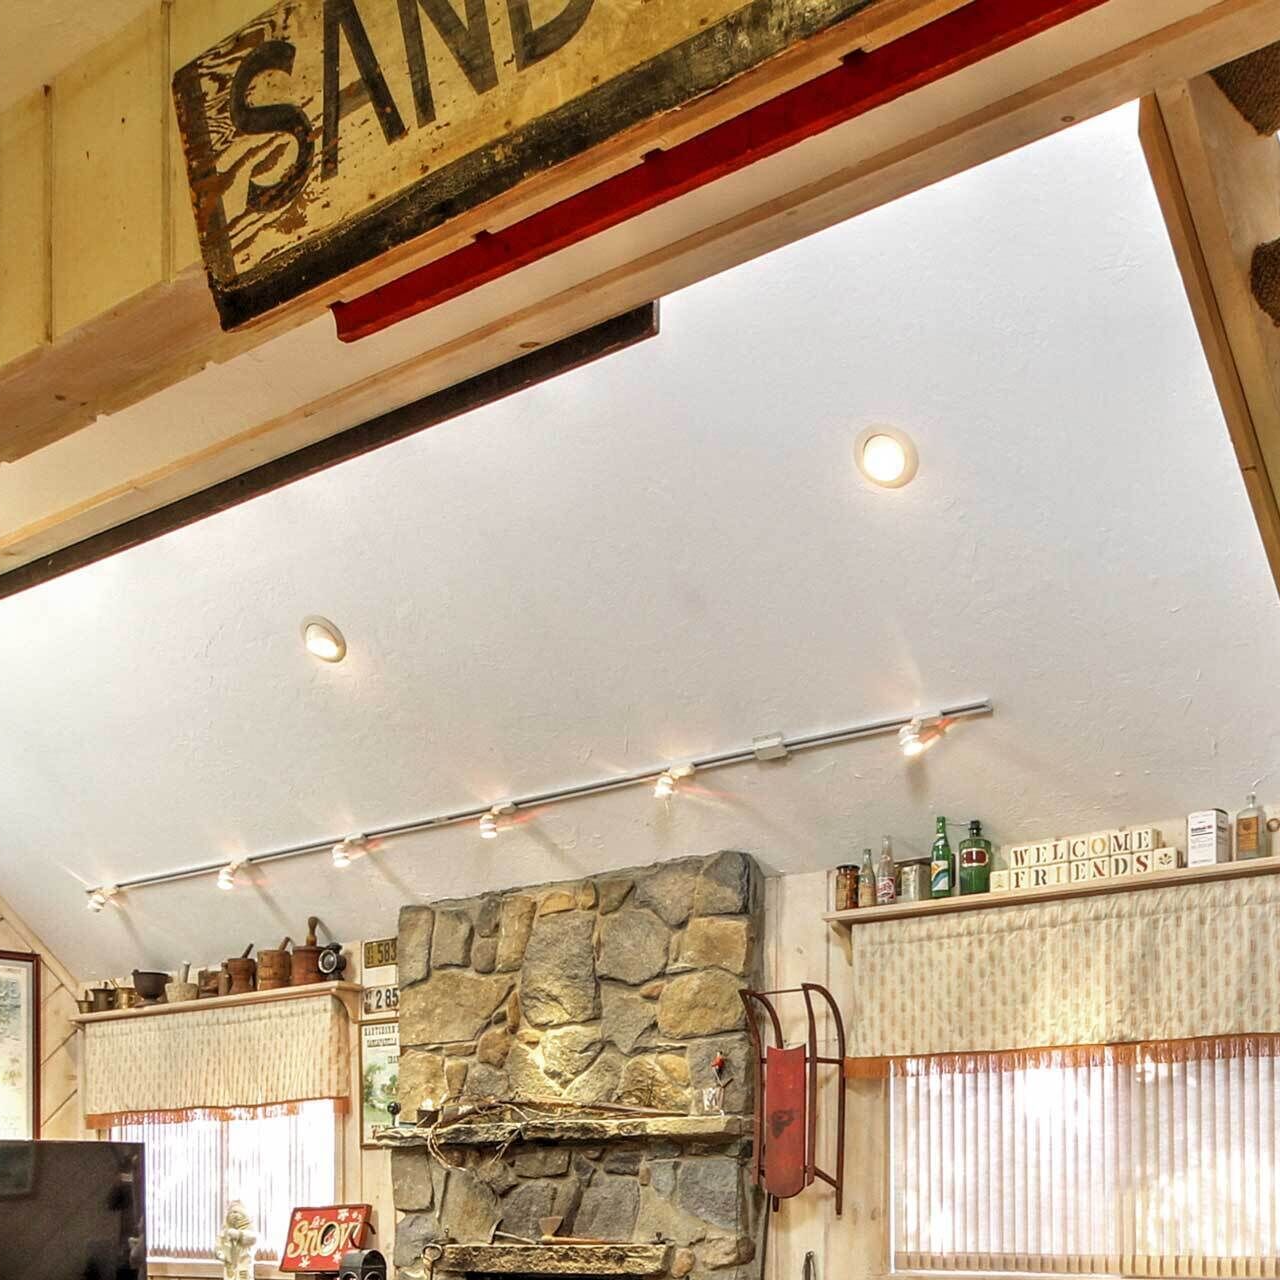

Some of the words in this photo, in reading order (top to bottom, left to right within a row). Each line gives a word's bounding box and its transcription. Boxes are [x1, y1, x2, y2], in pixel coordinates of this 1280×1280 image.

[1012, 830, 1150, 867] WELCOME
[1014, 855, 1150, 888] FRIENDS
[375, 988, 400, 1010] 285
